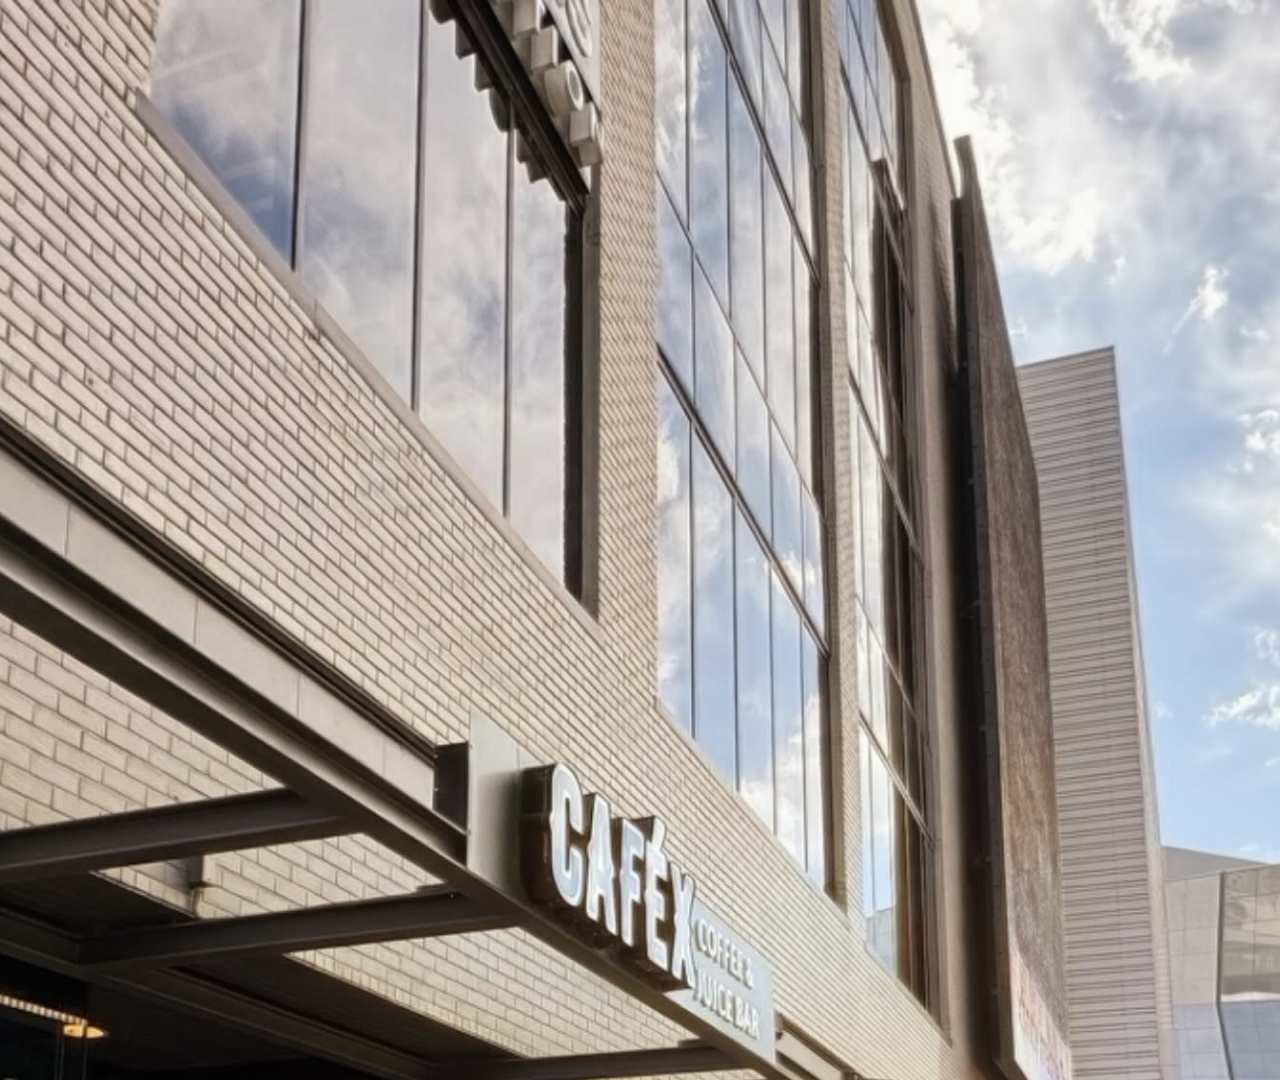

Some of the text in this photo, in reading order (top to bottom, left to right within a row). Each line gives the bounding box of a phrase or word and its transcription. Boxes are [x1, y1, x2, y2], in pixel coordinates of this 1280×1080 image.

[696, 919, 742, 981] COFFEE
[695, 970, 760, 1040] JUICE BAR
